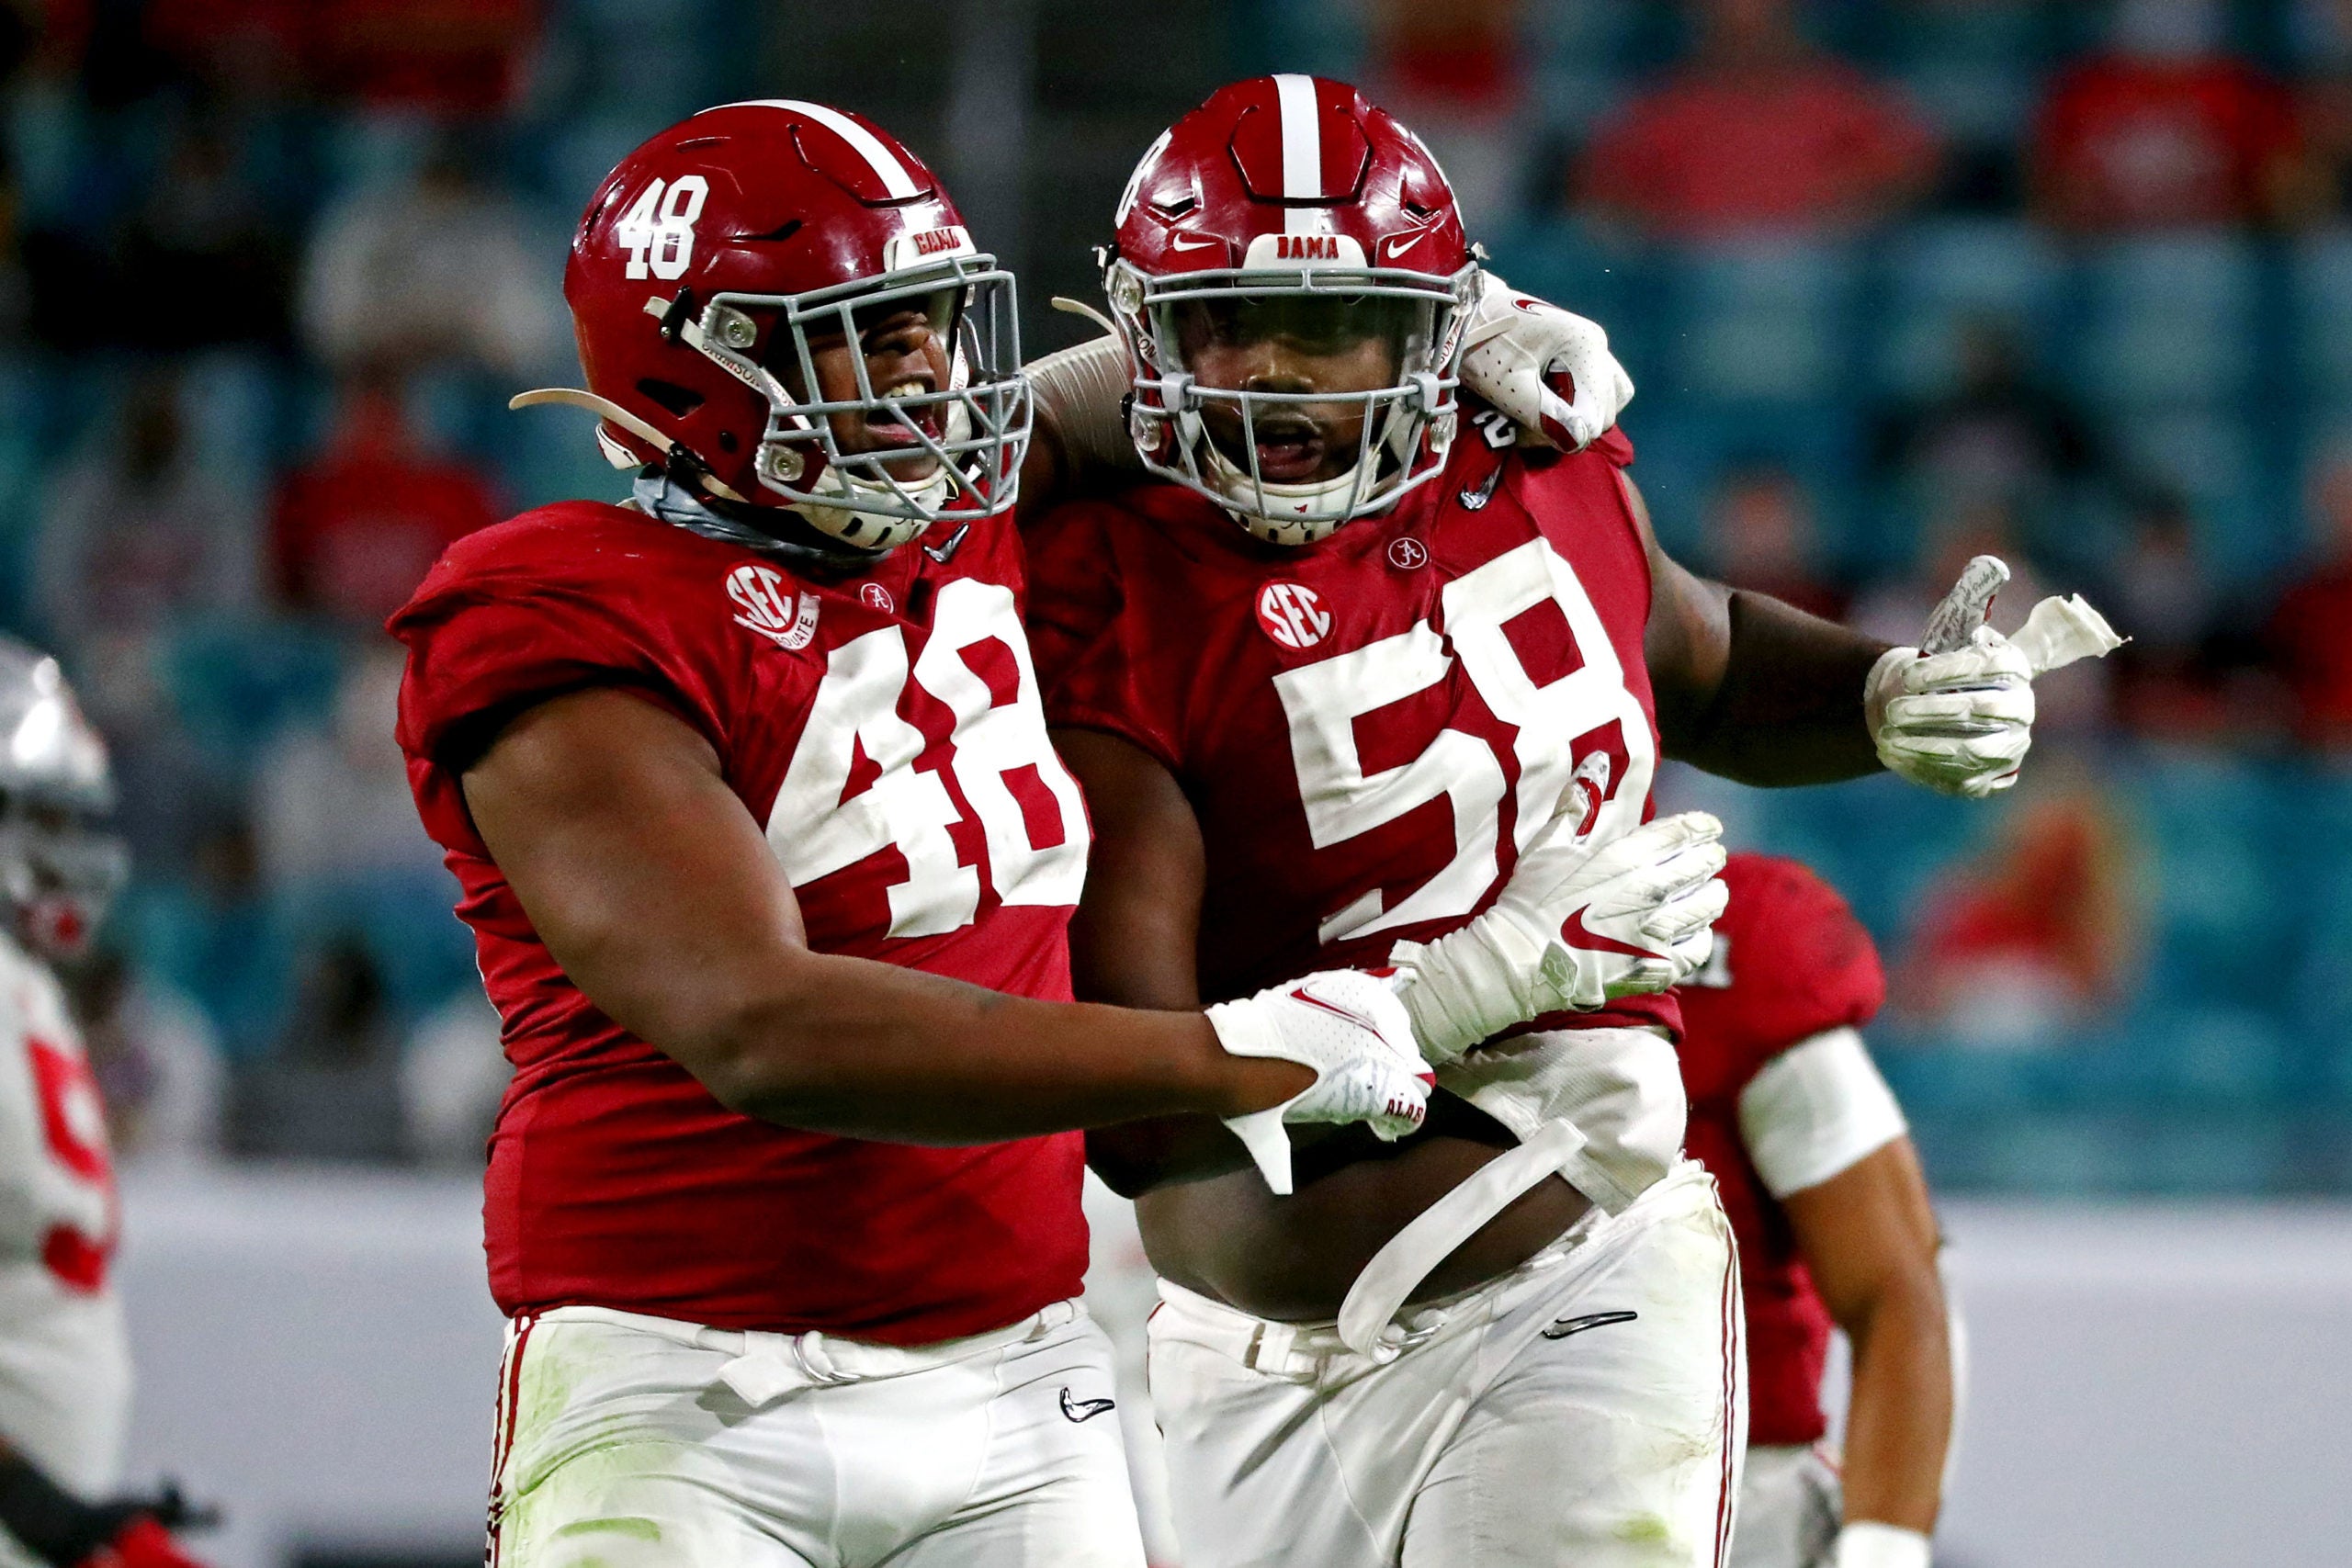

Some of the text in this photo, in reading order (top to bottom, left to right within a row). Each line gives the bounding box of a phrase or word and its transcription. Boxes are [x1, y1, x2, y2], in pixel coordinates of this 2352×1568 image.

[616, 175, 709, 280] 48
[912, 228, 961, 255] BAMA
[1277, 236, 1339, 259] BAMA
[726, 565, 793, 629] SEC
[1261, 583, 1331, 649] SEC
[764, 577, 1091, 941] 48
[1272, 536, 1655, 946] 58
